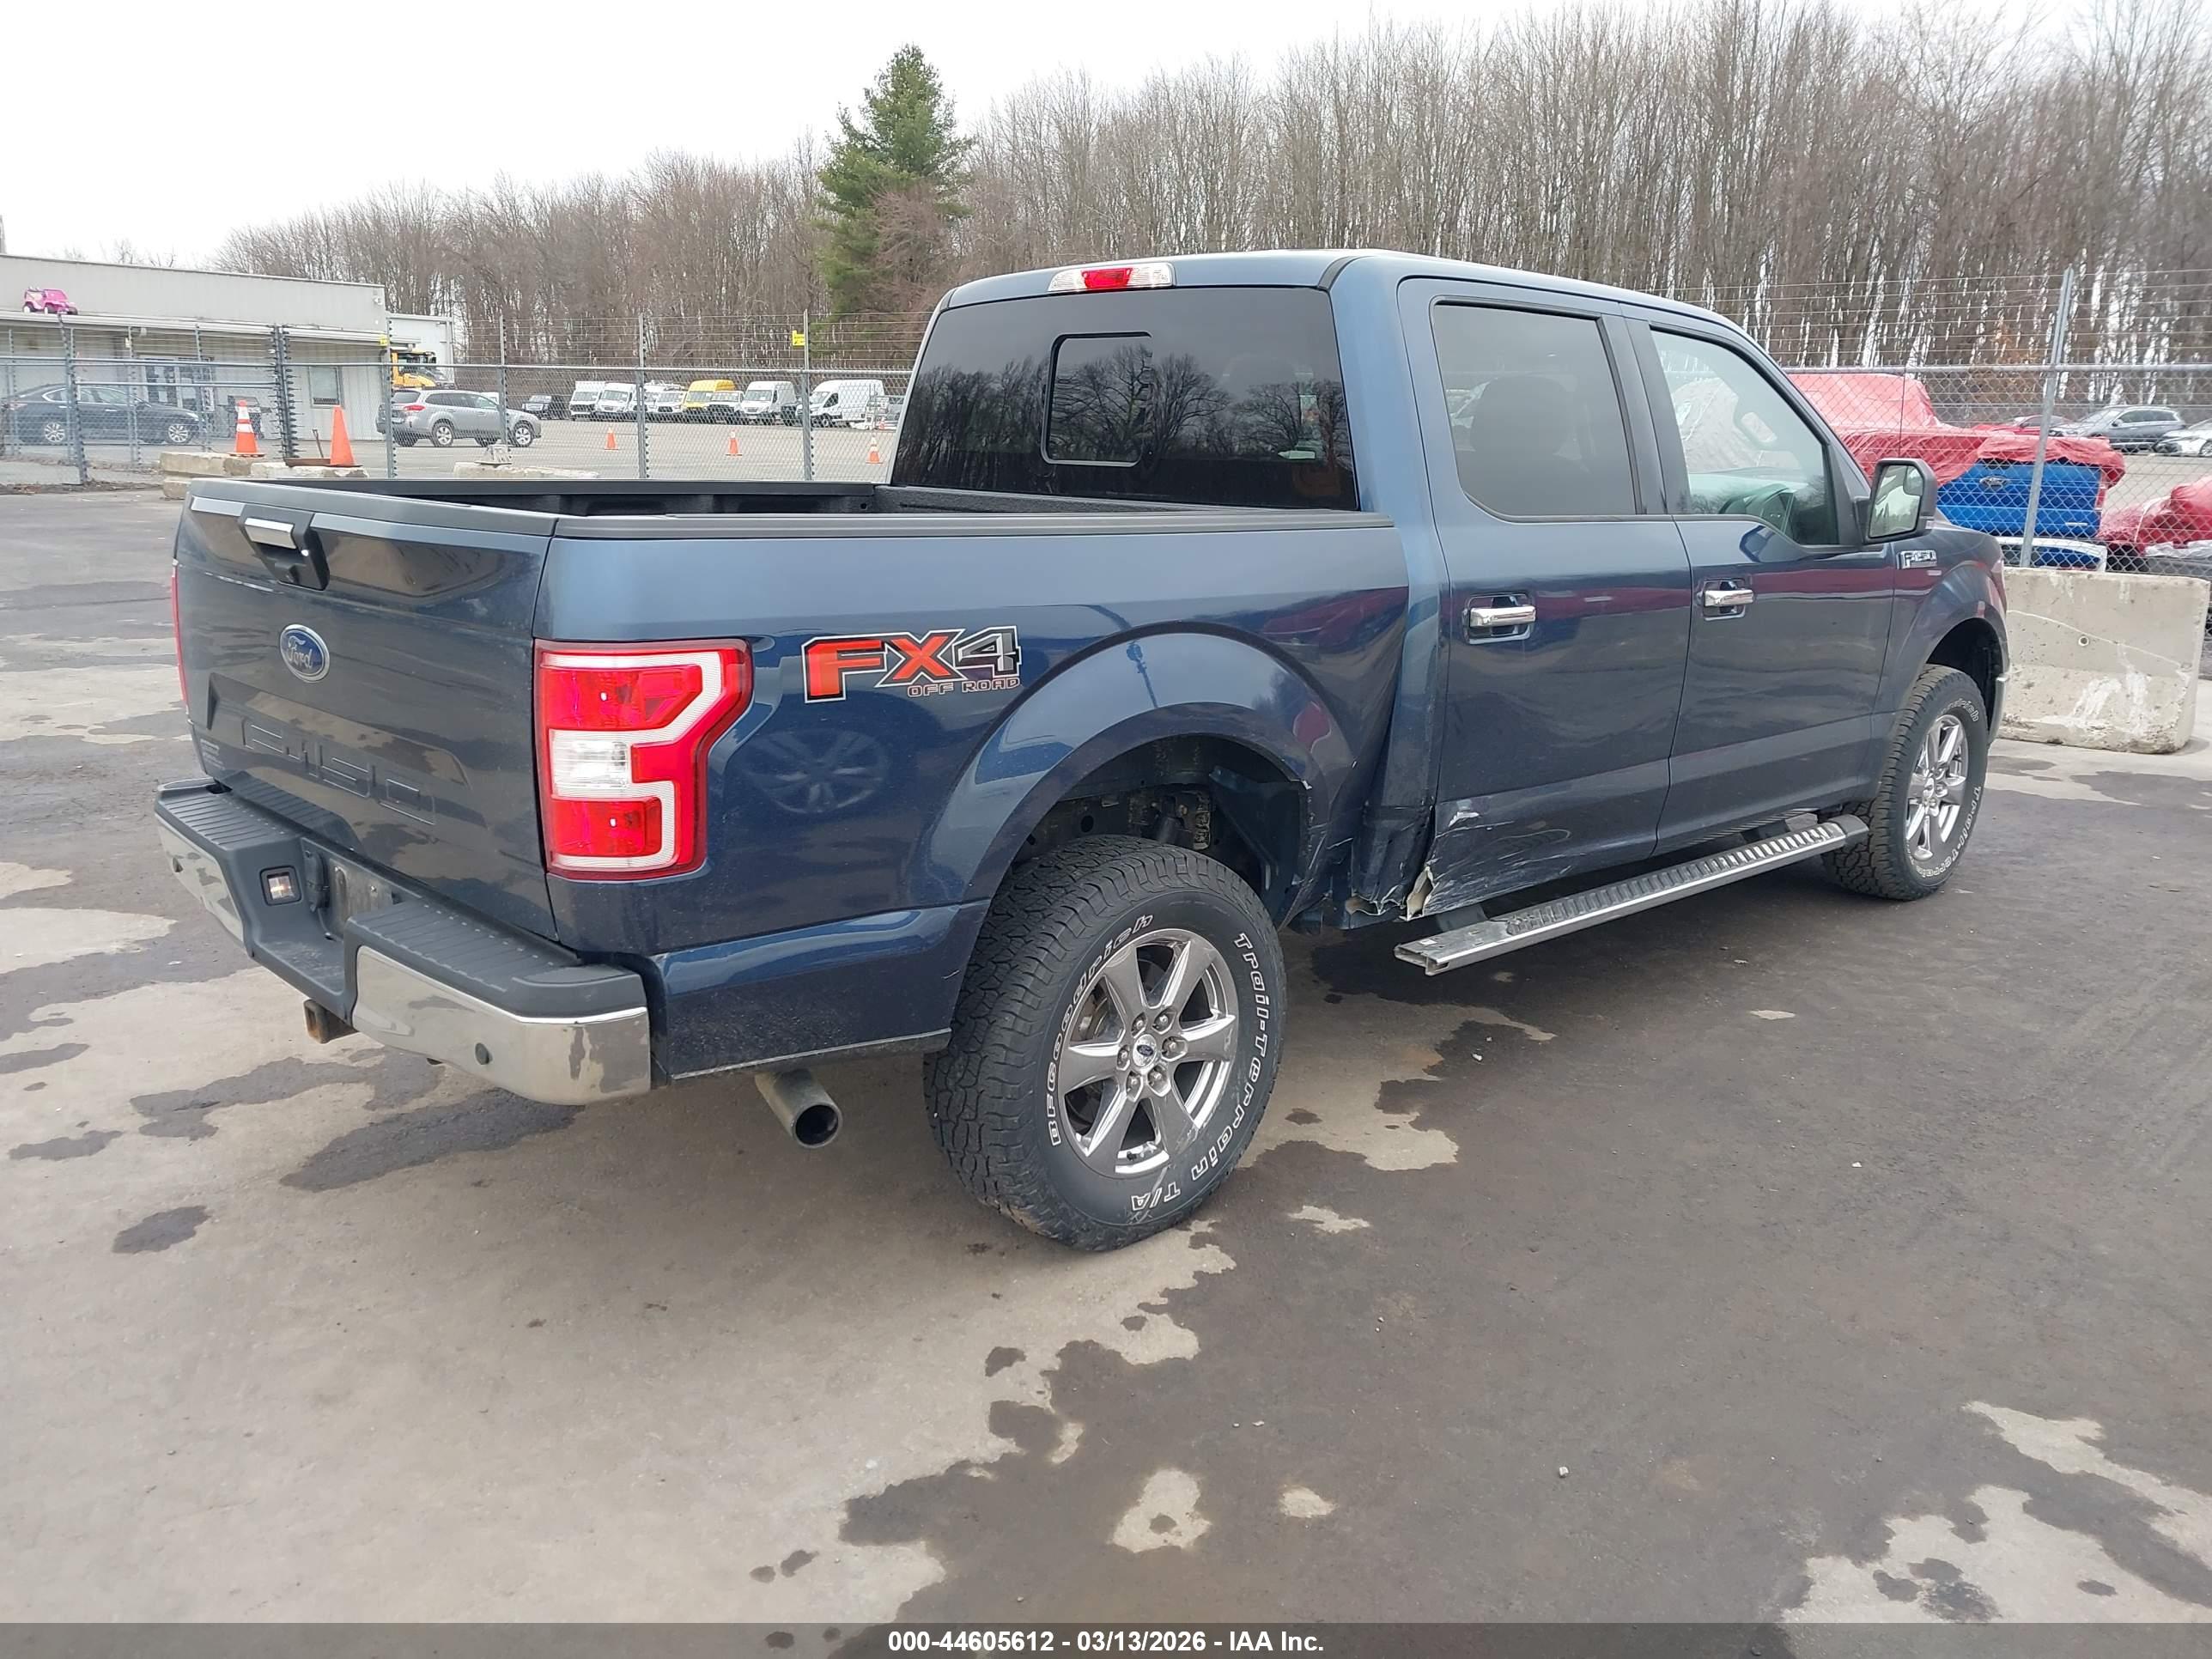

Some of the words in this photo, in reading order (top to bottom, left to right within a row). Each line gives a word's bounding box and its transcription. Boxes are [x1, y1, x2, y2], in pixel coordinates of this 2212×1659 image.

[288, 635, 313, 669] Ford
[801, 625, 1022, 703] FX4
[907, 682, 954, 697] OFF
[962, 678, 1021, 693] ROAD
[1046, 914, 1153, 1146] BFGoodrich
[1190, 933, 1271, 1182] Trail-Terrain
[1130, 1181, 1182, 1211] T/A
